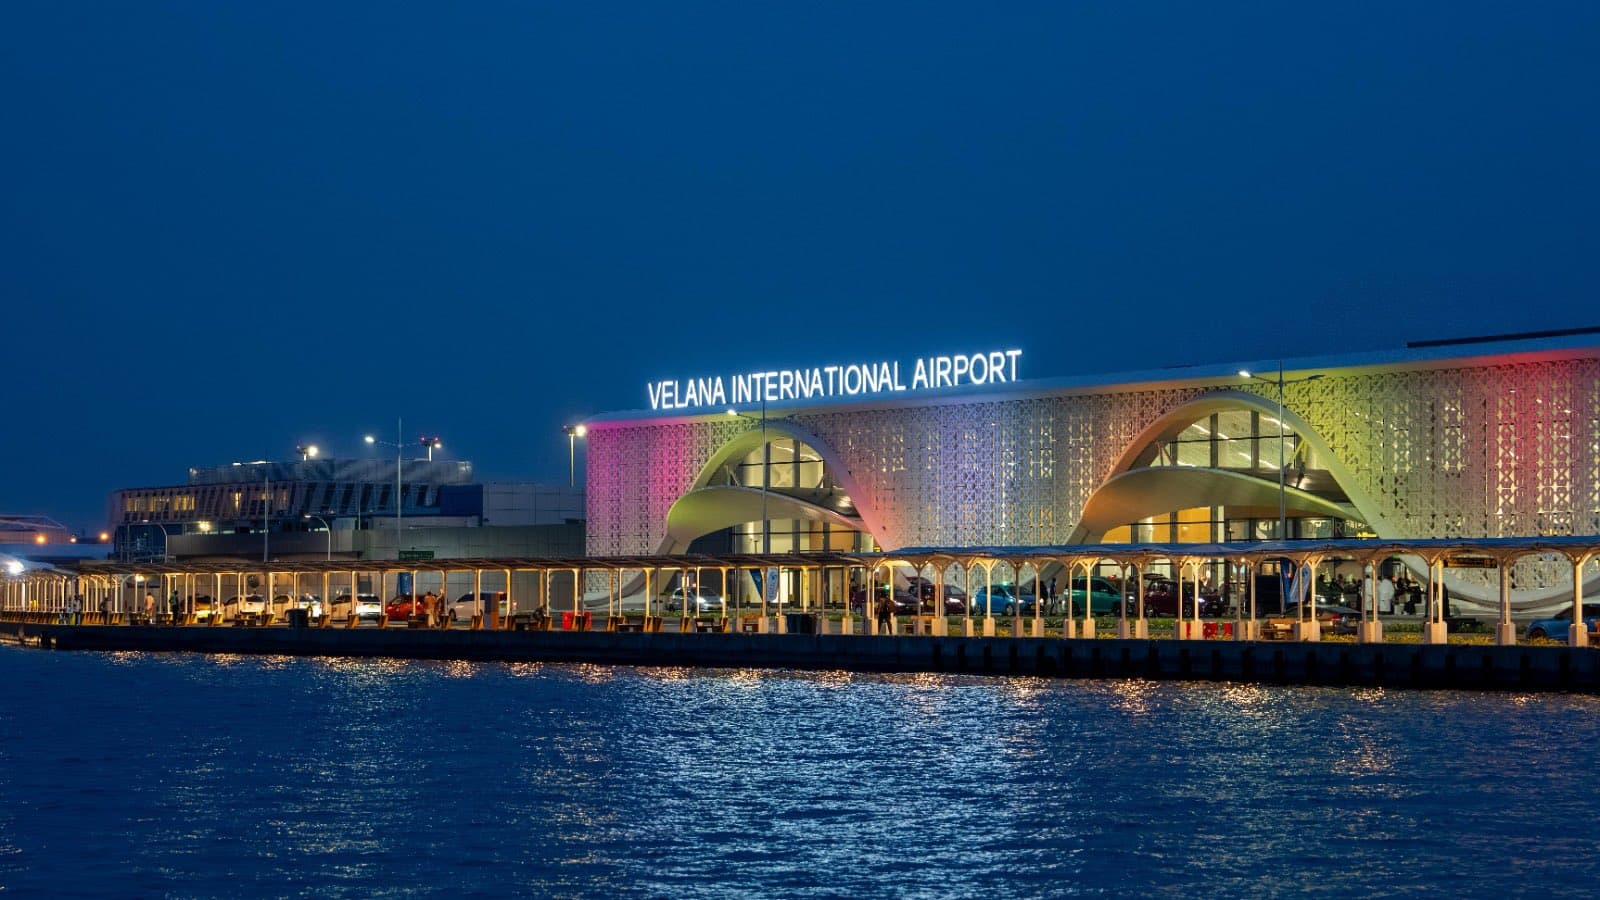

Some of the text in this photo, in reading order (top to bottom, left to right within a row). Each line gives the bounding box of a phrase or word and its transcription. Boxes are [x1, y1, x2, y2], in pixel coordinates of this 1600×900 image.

[646, 349, 1023, 409] VELANA INTERNATIONAL AIRPORT
